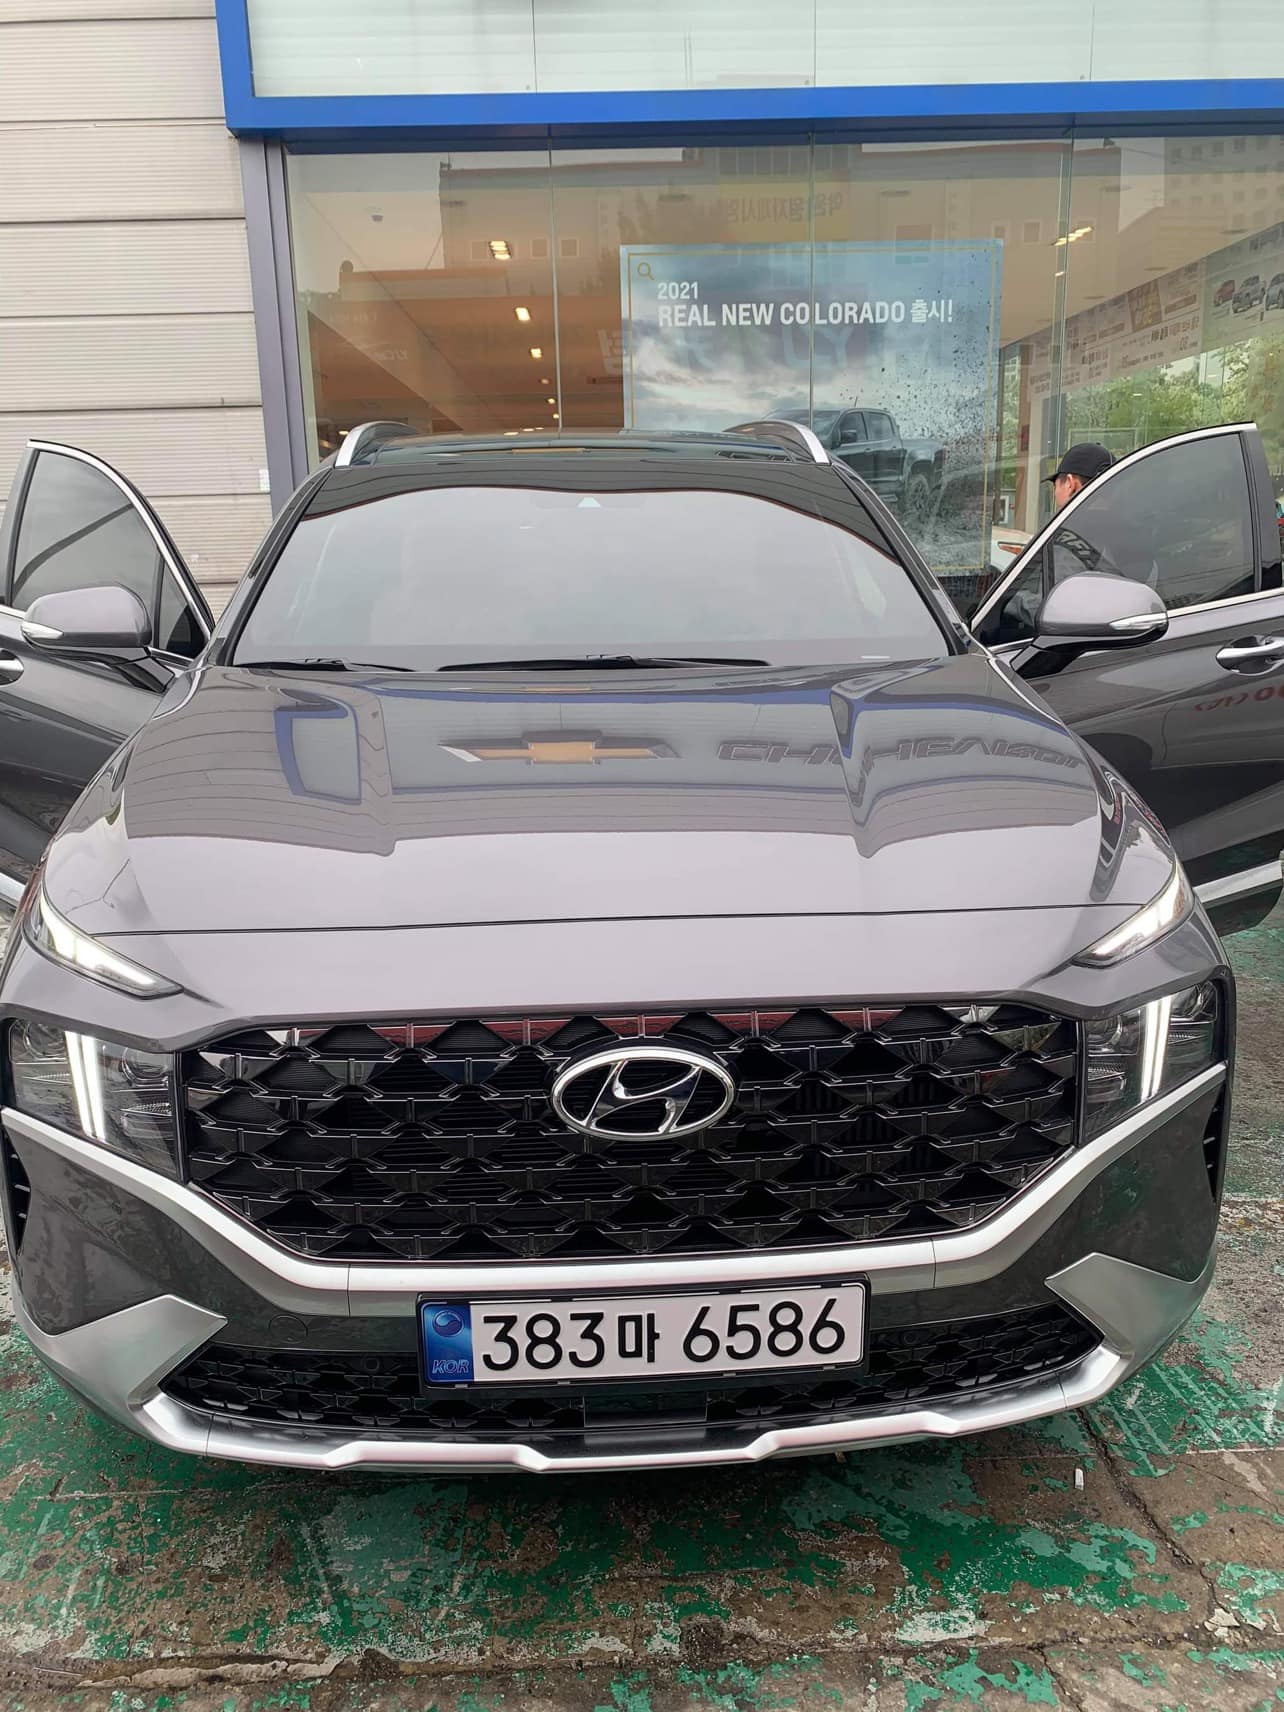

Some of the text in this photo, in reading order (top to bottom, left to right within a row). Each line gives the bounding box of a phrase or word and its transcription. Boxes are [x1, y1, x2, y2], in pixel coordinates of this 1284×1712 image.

[657, 281, 699, 300] 2021
[657, 299, 953, 327] REAL NEW COLORADO 출시!
[481, 1298, 846, 1371] 383마 6586
[431, 1358, 470, 1375] KOR
